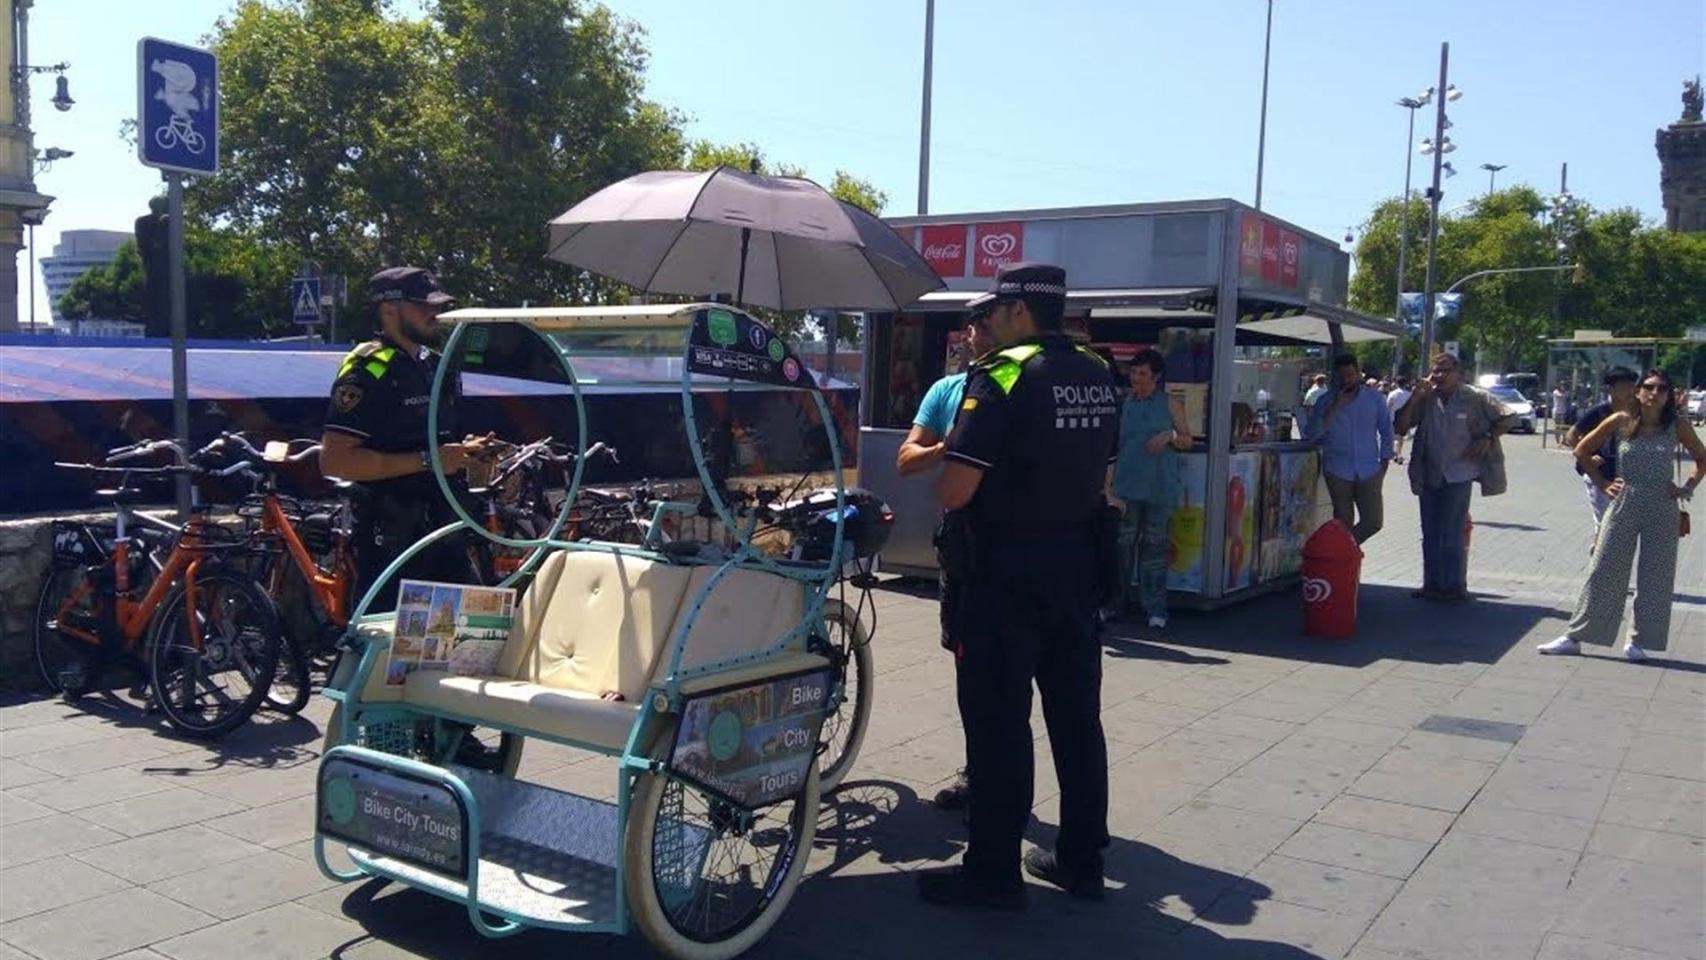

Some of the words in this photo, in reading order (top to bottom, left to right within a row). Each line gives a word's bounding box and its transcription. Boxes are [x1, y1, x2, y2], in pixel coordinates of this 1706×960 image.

[1052, 385, 1115, 404] POLICIA
[791, 686, 822, 705] Bike
[784, 728, 811, 748] City
[760, 770, 798, 794] Tours
[363, 798, 392, 820] Bike
[393, 806, 420, 832] City
[422, 814, 458, 841] Tours
